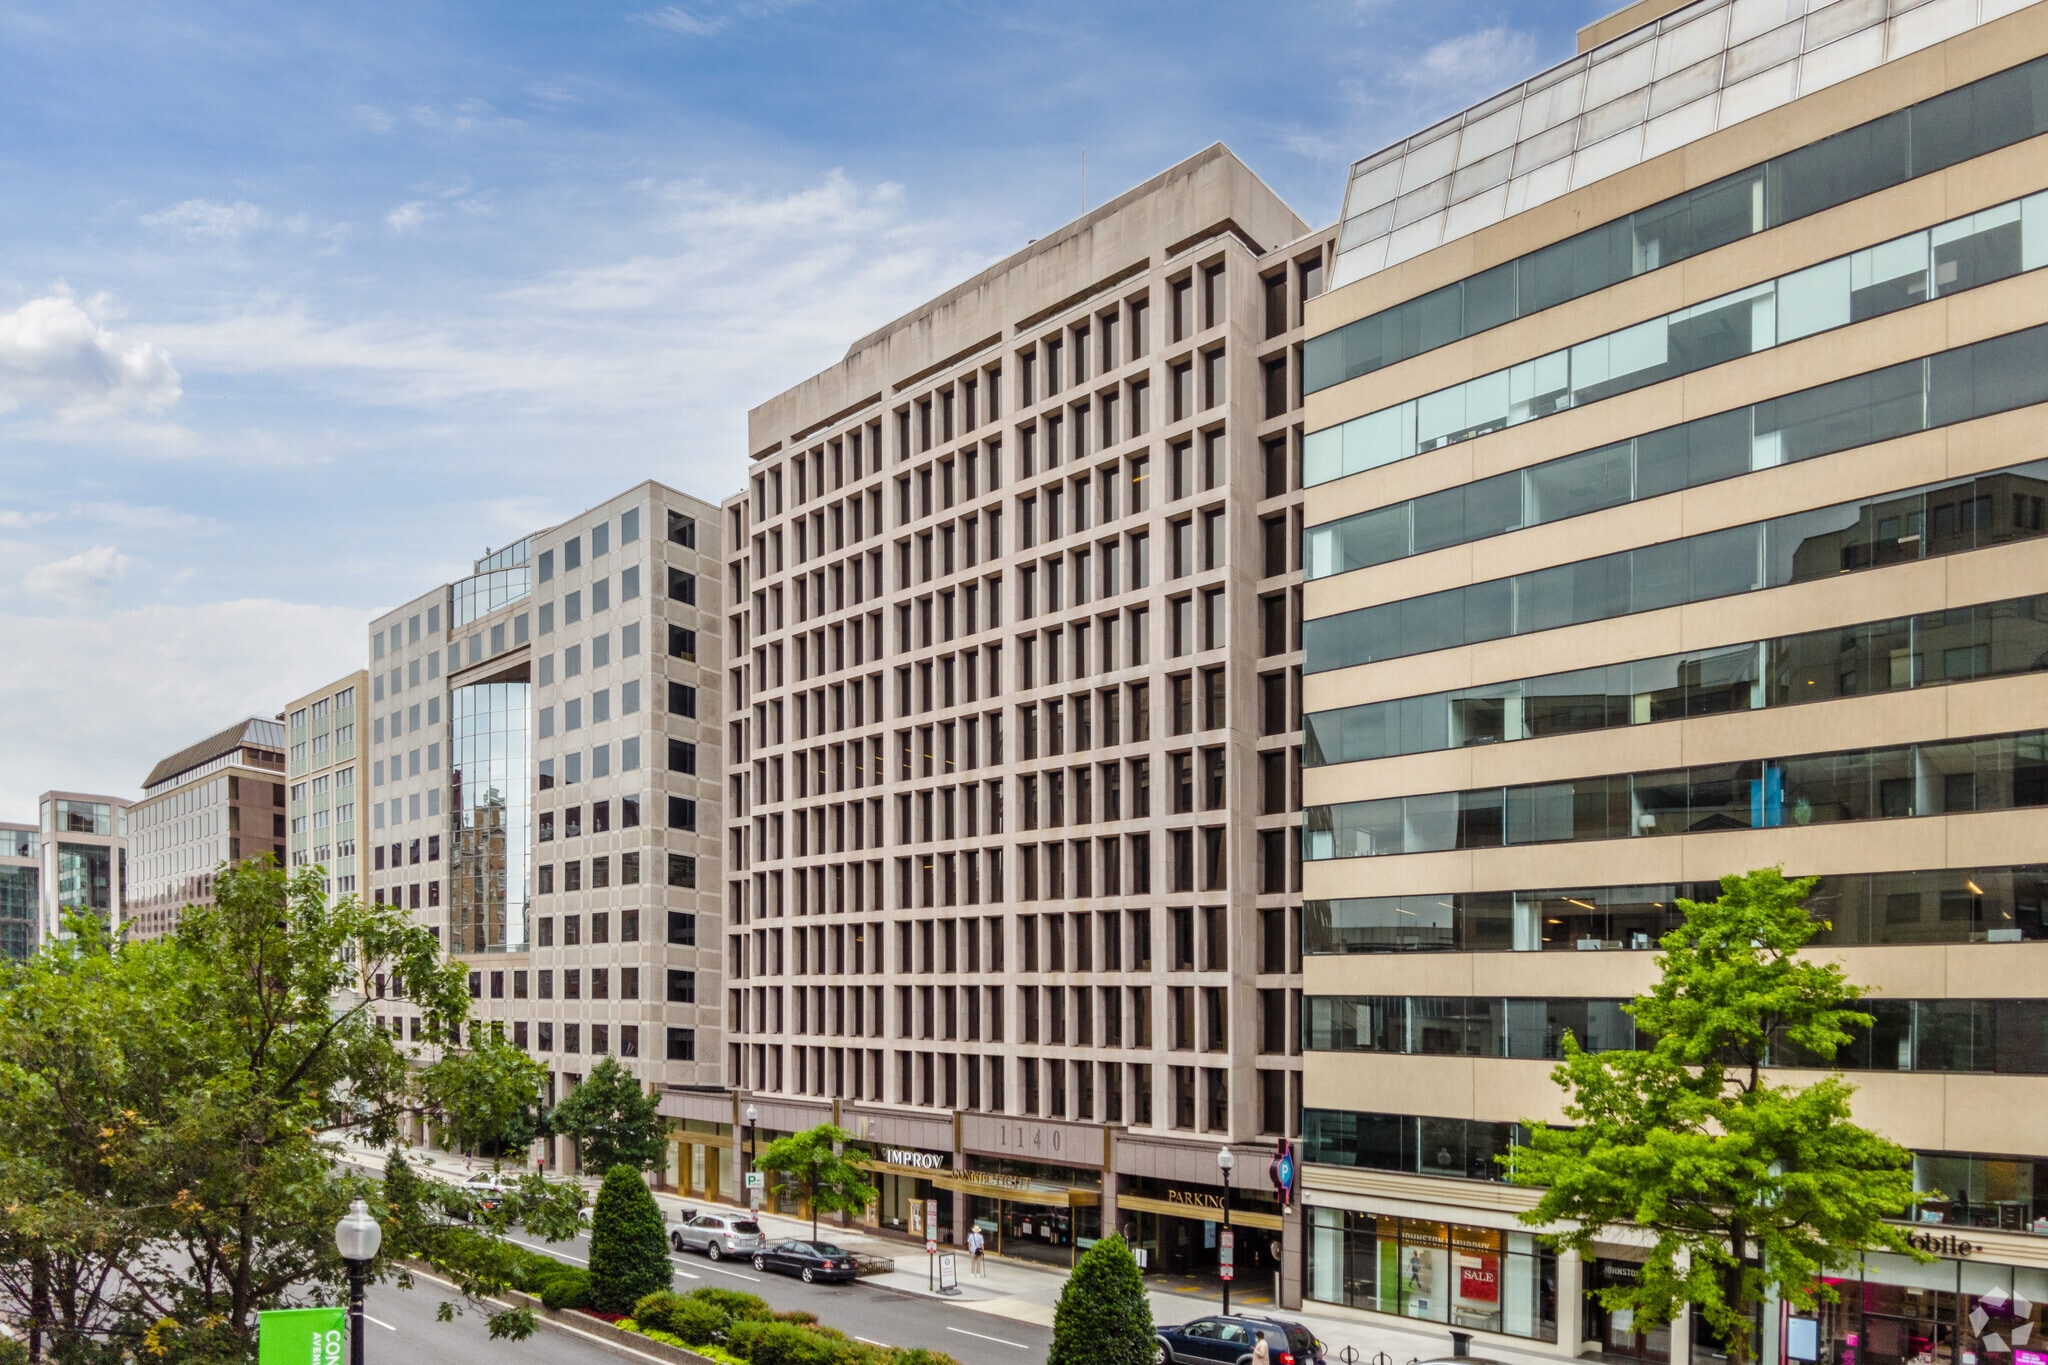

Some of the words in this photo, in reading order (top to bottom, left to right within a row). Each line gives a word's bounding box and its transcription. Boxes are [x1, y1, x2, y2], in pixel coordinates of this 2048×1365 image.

[1001, 1125, 1061, 1151] 1140
[887, 1149, 944, 1169] IMPROV
[747, 1175, 757, 1186] P
[951, 1167, 1032, 1192] CONNECTICUT
[1281, 1164, 1289, 1181] P
[1904, 1231, 1973, 1256] obile
[1464, 1269, 1494, 1283] SALE
[1603, 1265, 1640, 1278] JOHNSTO
[313, 1332, 322, 1365] AVEN
[325, 1330, 341, 1365] CON
